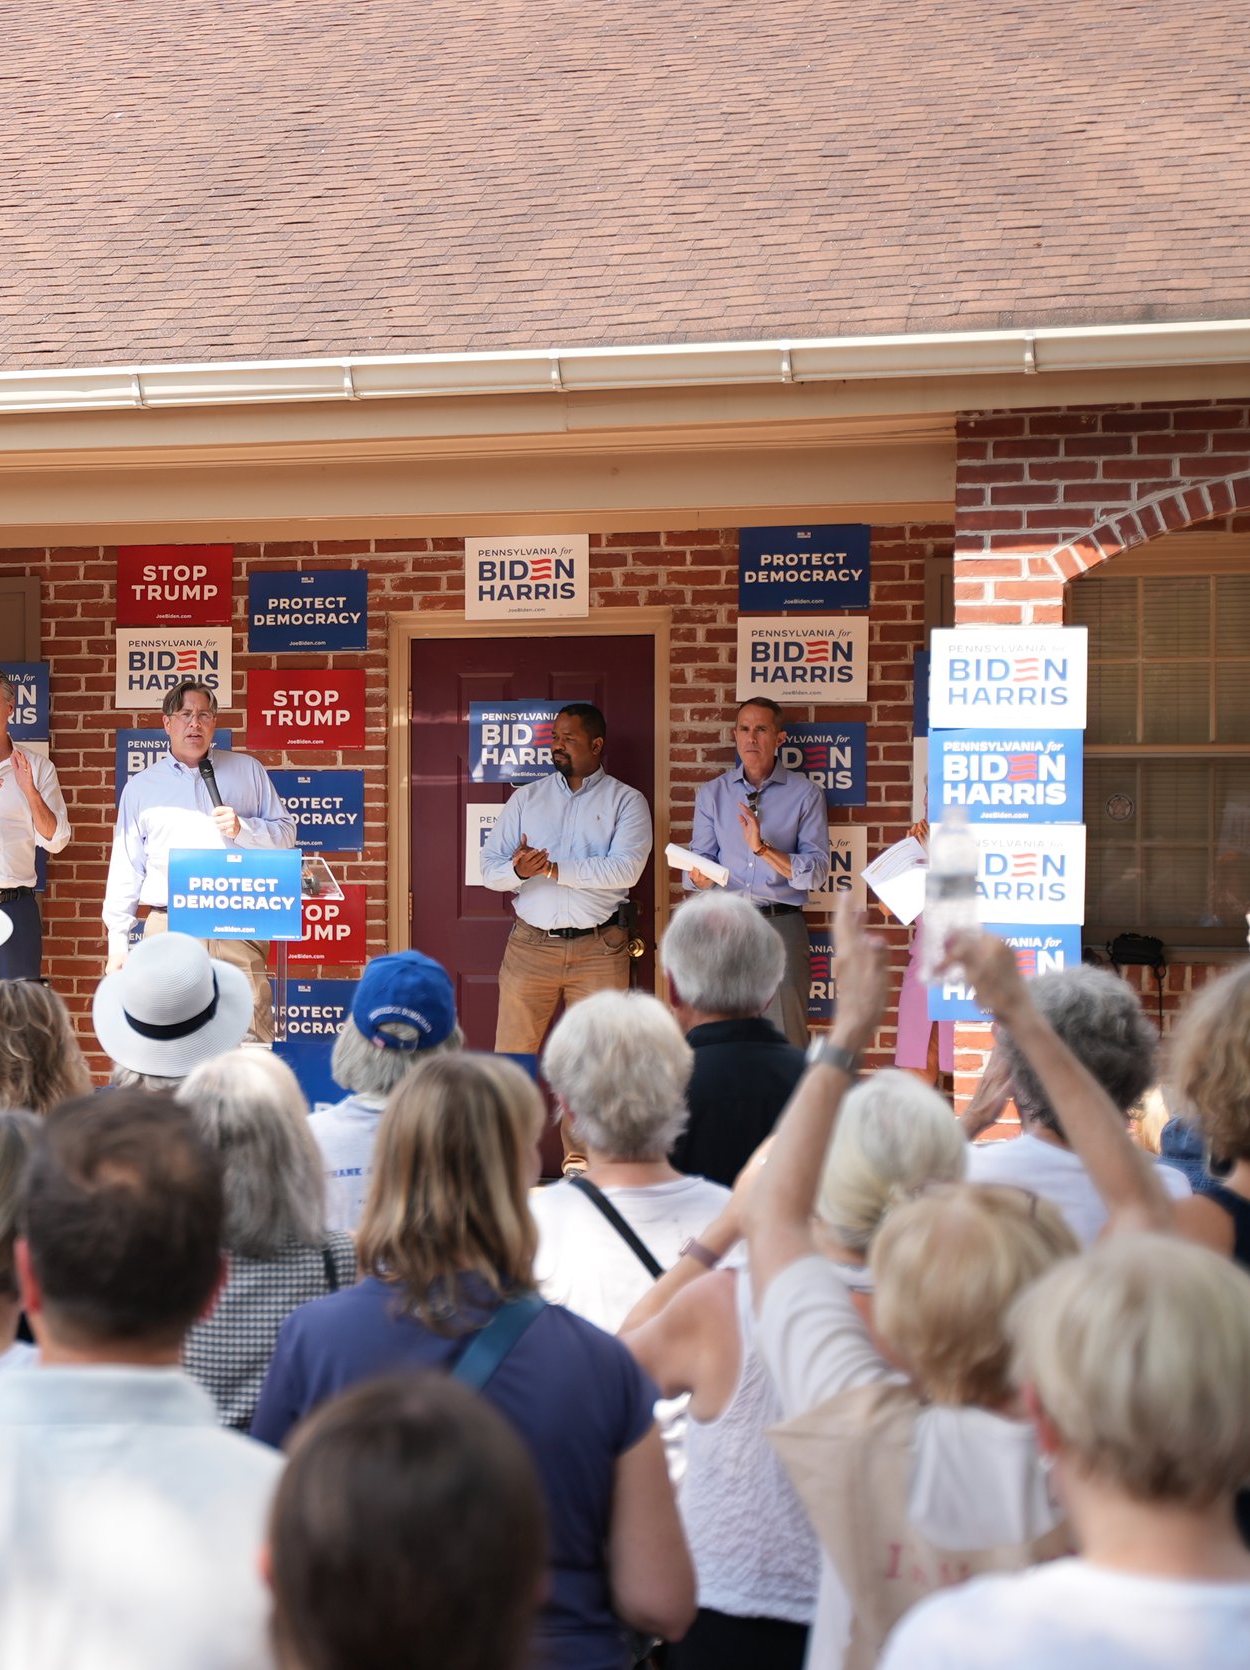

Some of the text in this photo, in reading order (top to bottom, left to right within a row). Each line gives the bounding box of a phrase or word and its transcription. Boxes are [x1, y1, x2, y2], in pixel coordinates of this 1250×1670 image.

[478, 546, 574, 557] PENNSYLVANIA for
[760, 552, 847, 566] PROTECT
[142, 565, 208, 582] STOP
[478, 558, 575, 582] BIDEN
[744, 569, 863, 583] DEMOCRACY
[131, 585, 218, 601] TRUMP
[478, 582, 576, 602] HARRIS
[268, 596, 348, 610] PROTECT
[254, 612, 362, 626] DEMOCRACY
[751, 628, 852, 639] PENNSYLVANIA for
[128, 638, 218, 649] PENNSYLVANIA for
[751, 640, 853, 663] BIDEN
[948, 644, 1047, 653] PENNSYLVANIA
[128, 650, 218, 672] BIDEN
[750, 665, 854, 683] HARRIS
[948, 658, 1068, 682] BIDEN
[22, 674, 36, 684] for
[273, 690, 340, 707] STOP
[948, 686, 1068, 706] HARRIS
[262, 710, 351, 726] TRUMP
[482, 724, 554, 746] BIDE
[786, 734, 851, 745] YLVANIA for
[943, 740, 1064, 754] PENNSYLVANIA for
[481, 748, 554, 766] HARR
[782, 746, 852, 769] DEN
[942, 753, 1066, 782] BIDEN
[942, 782, 1067, 806] HARRIS
[291, 813, 358, 825] OCRACY
[836, 839, 851, 848] for
[985, 852, 1066, 878] DEN
[188, 877, 279, 893] PROTECT
[974, 881, 1066, 902] ARRIS
[172, 894, 296, 911] DEMOCRACY
[213, 926, 256, 934] JoeBiden.com
[1043, 936, 1062, 950] for
